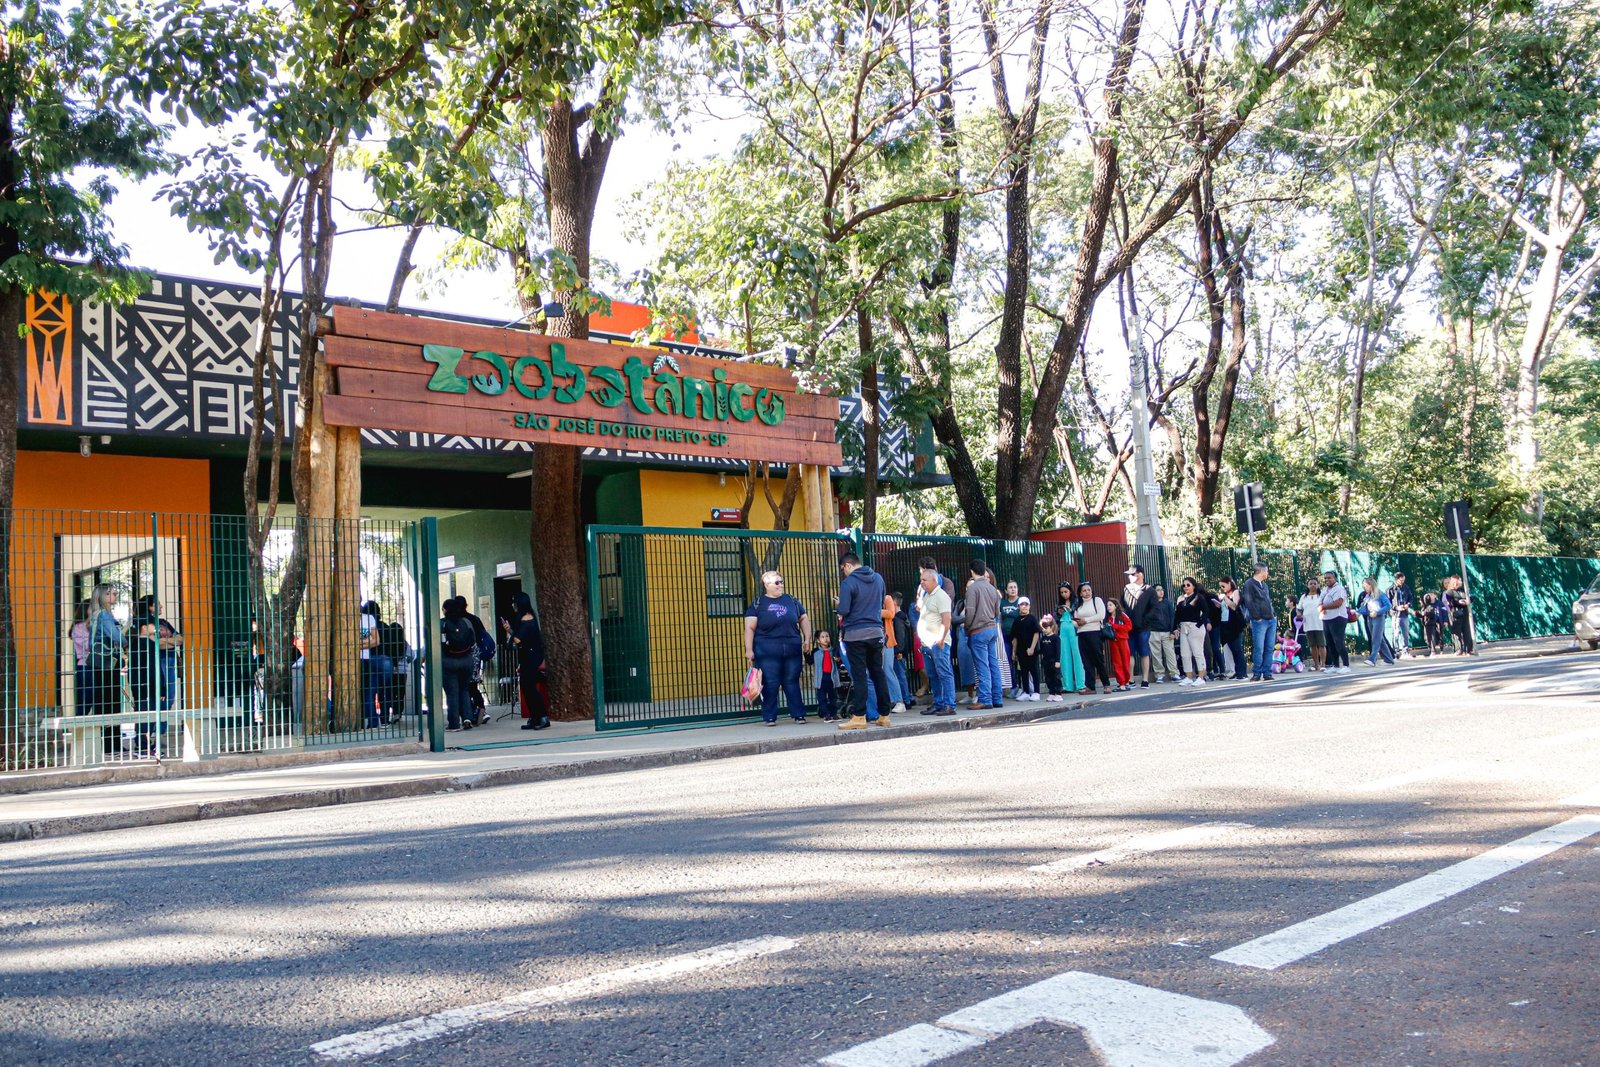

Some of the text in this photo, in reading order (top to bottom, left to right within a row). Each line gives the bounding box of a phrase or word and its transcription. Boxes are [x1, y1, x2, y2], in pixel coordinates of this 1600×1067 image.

[514, 411, 550, 430] SÃO
[555, 417, 596, 434] JOSÉ
[599, 422, 623, 436] DO
[626, 425, 652, 439] RIO
